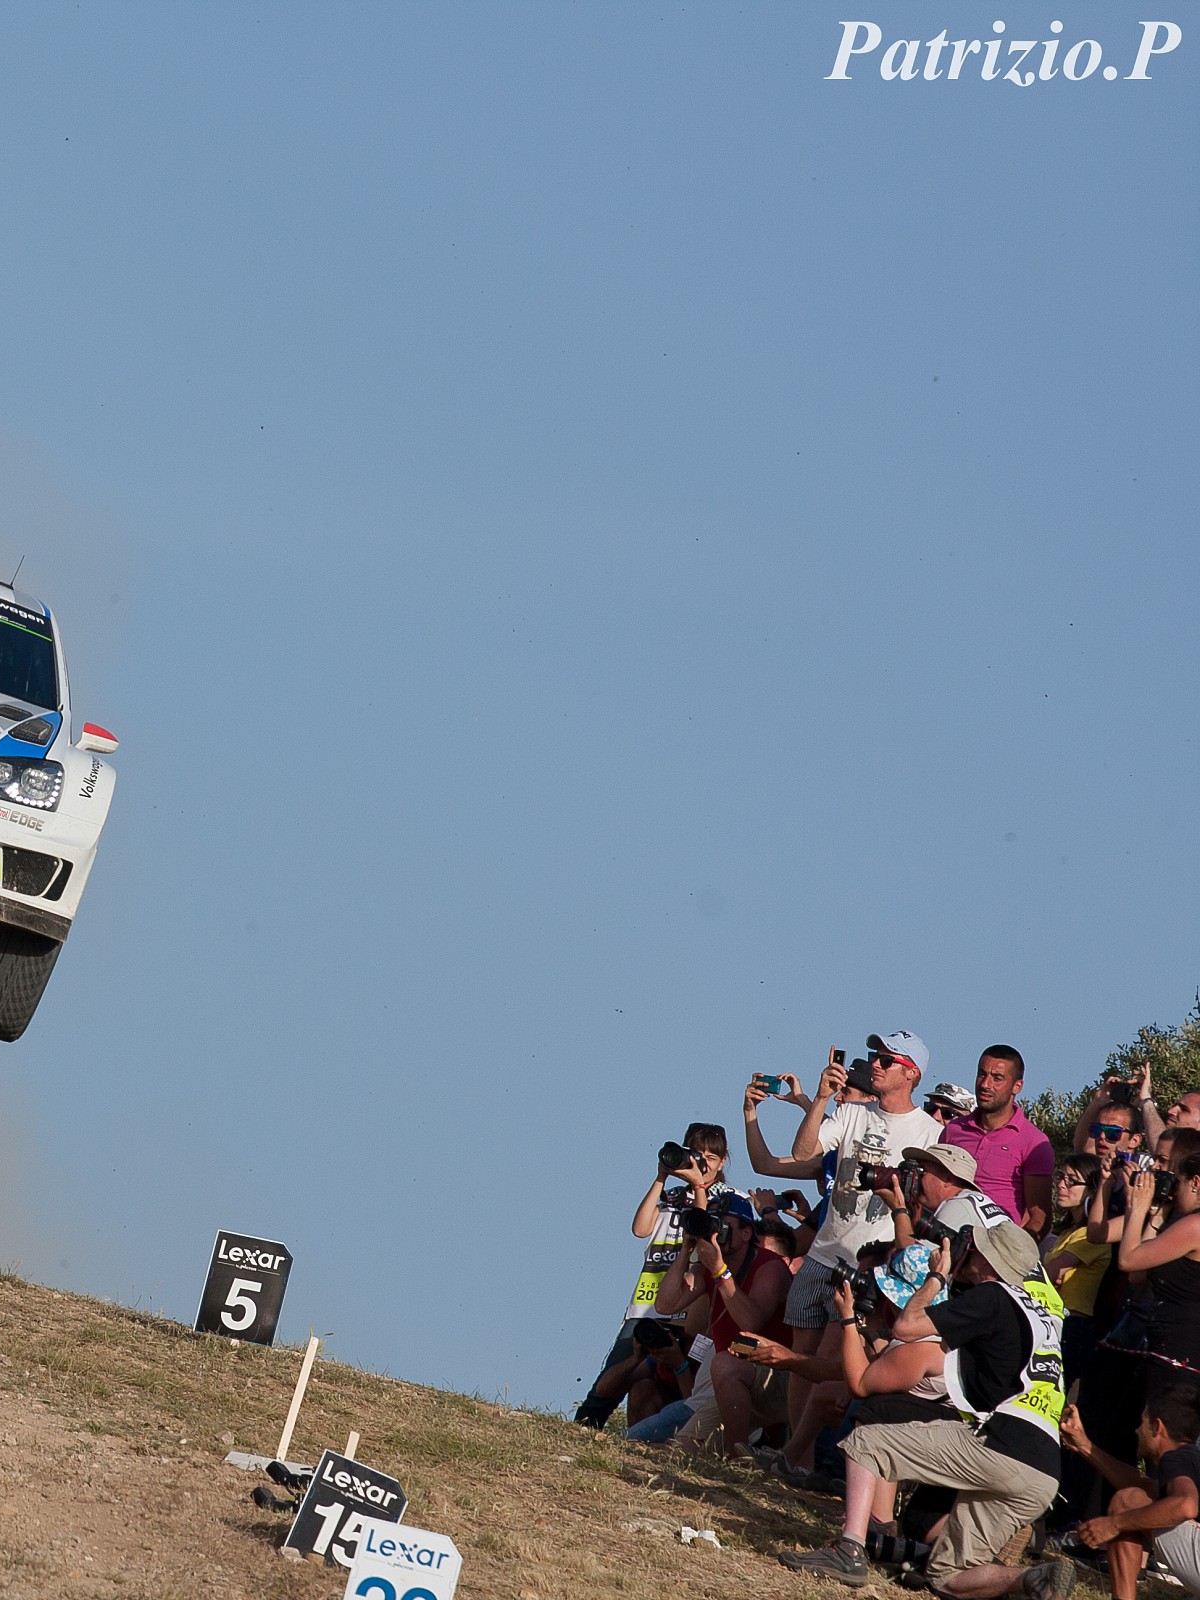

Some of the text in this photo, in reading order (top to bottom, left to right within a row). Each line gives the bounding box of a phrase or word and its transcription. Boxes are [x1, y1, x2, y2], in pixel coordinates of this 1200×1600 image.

[9, 811, 45, 833] EDGE
[218, 1239, 286, 1270] Lexar
[646, 1249, 681, 1263] Lexa
[220, 1277, 263, 1331] 5
[1018, 1393, 1049, 1415] 2014
[322, 1459, 398, 1508] Lexar
[312, 1501, 366, 1569] 15
[365, 1529, 450, 1570] Lexar
